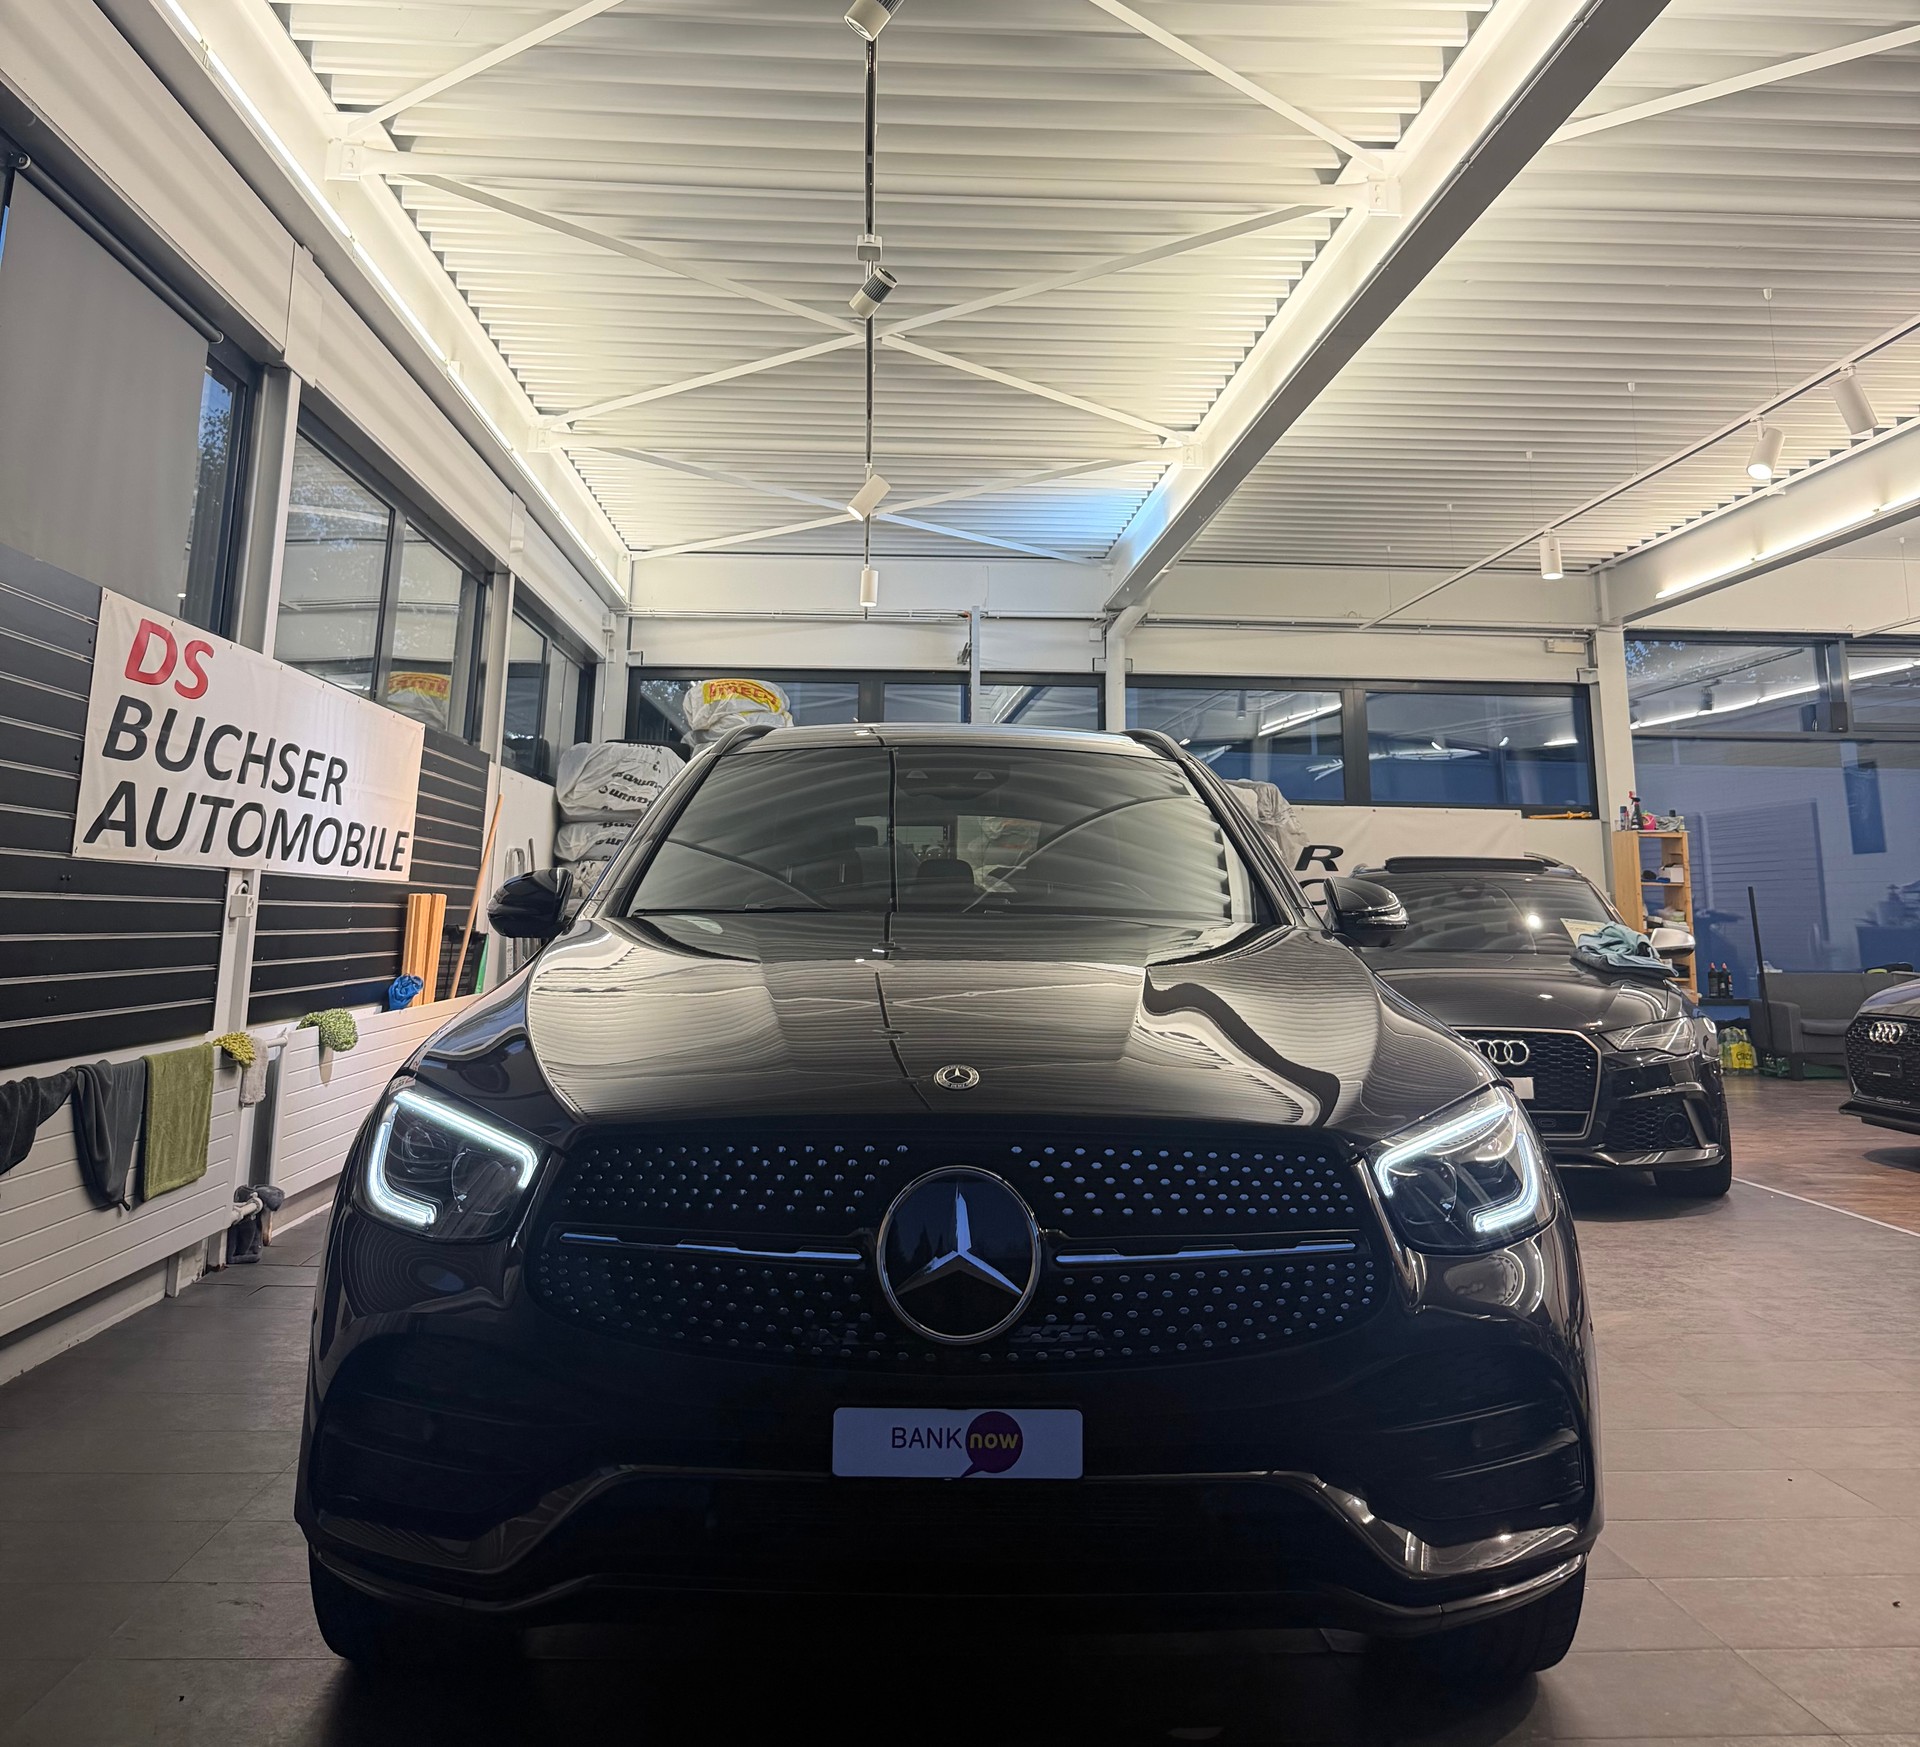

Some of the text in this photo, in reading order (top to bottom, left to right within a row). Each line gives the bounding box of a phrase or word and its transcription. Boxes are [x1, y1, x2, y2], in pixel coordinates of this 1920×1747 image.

[124, 618, 215, 699] DS
[101, 695, 348, 806] BUCHSER
[83, 780, 410, 872] AUTOMOBILE
[891, 1427, 1019, 1449] BANK now
